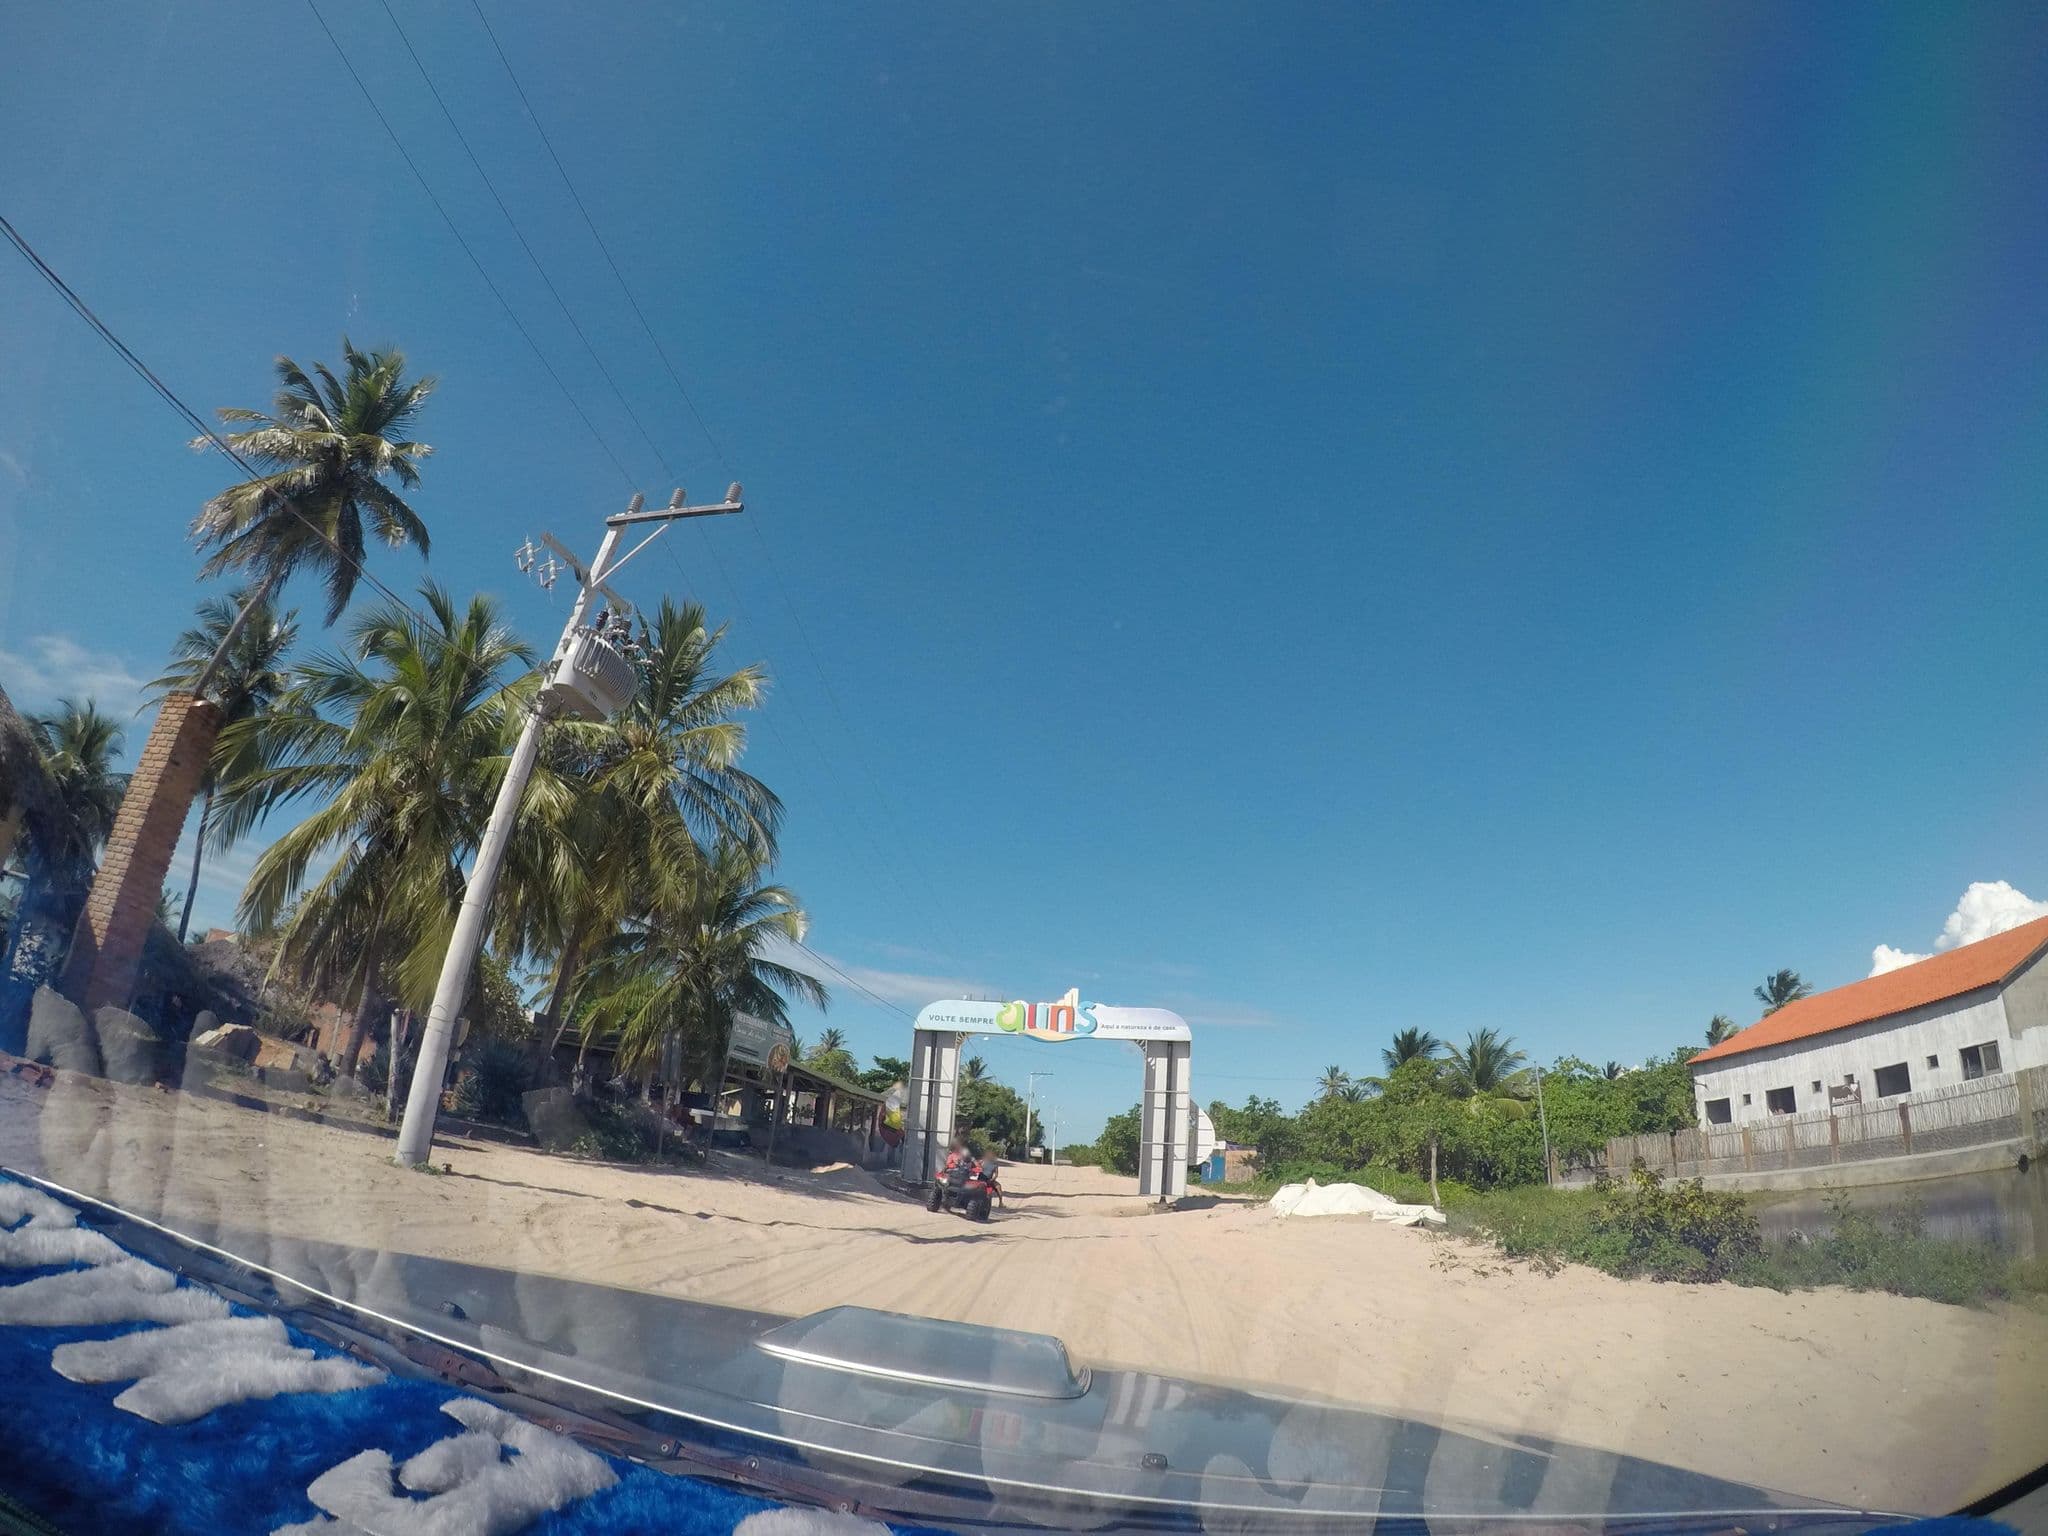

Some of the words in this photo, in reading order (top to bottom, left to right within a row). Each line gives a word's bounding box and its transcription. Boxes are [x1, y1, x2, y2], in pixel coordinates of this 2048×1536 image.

[929, 1014, 956, 1022] VOLTE
[959, 1016, 994, 1025] SEMPRE
[1101, 1023, 1114, 1031] Aqui
